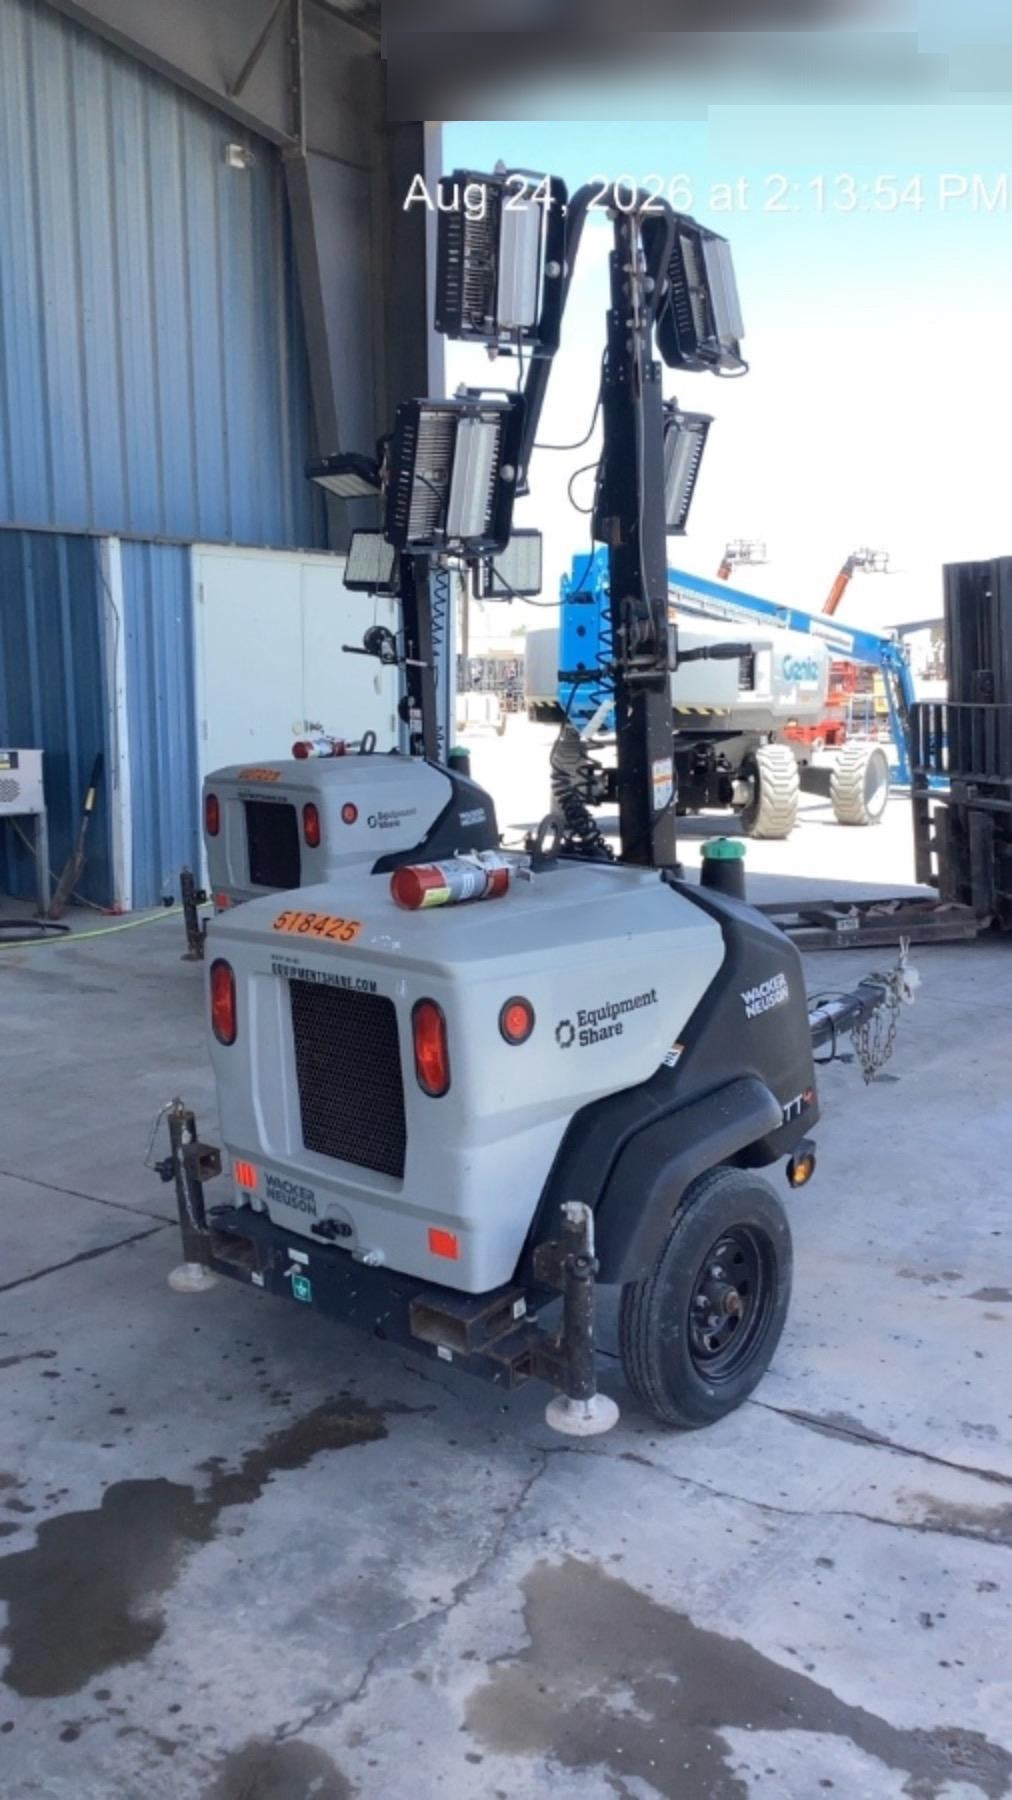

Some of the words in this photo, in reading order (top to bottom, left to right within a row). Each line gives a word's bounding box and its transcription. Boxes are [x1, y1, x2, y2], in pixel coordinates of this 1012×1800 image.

[782, 654, 819, 682] Genie
[273, 911, 361, 942] 518425
[740, 972, 786, 1005] WACKER
[576, 987, 659, 1028] Equipment
[578, 1022, 623, 1047] Share
